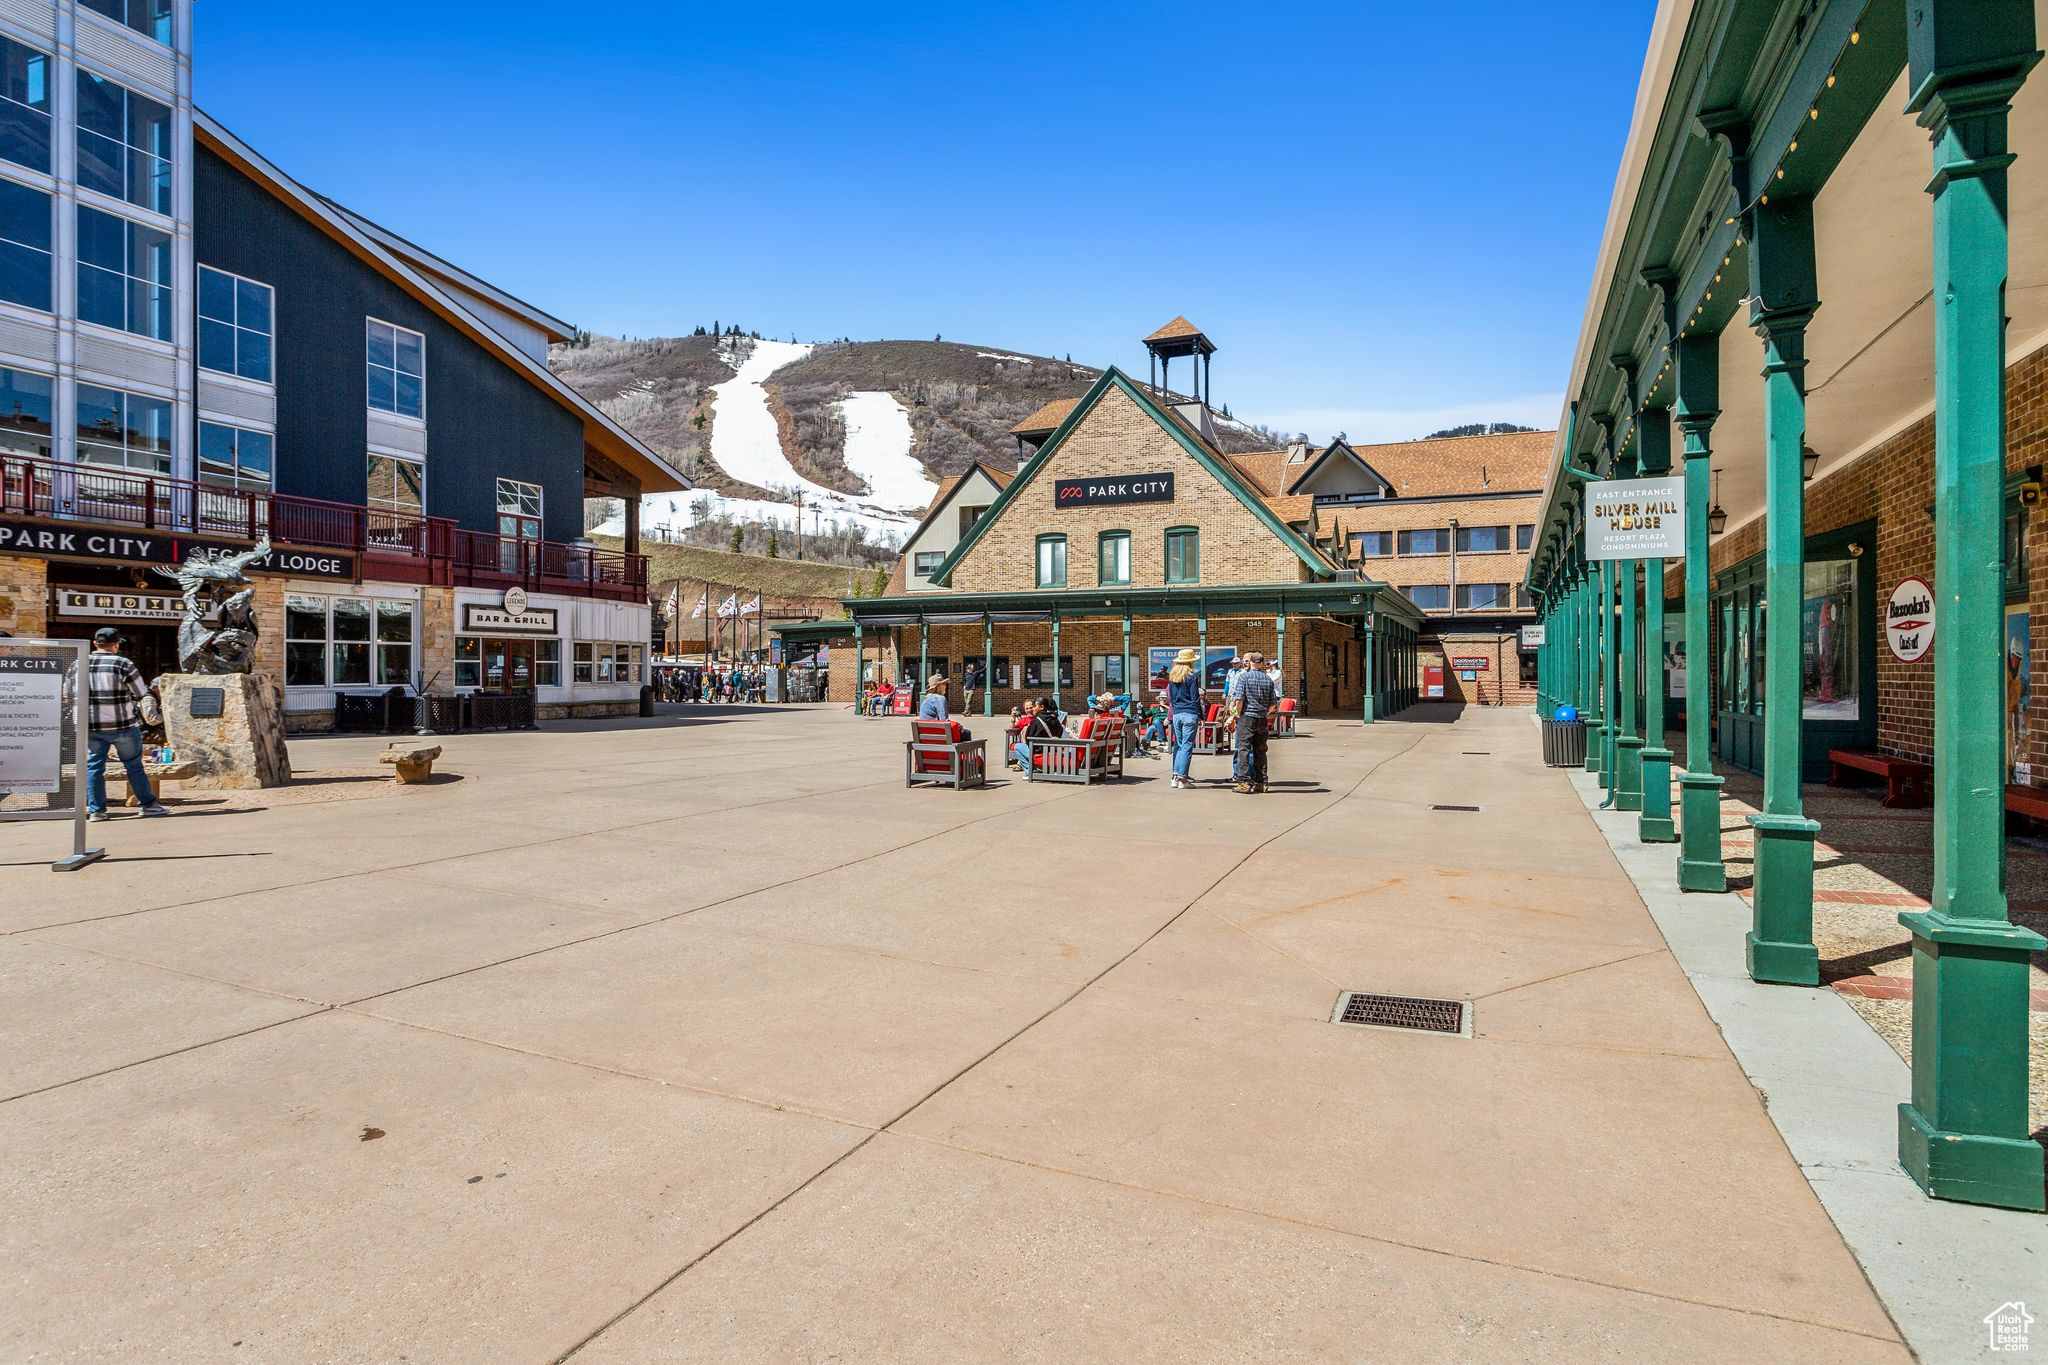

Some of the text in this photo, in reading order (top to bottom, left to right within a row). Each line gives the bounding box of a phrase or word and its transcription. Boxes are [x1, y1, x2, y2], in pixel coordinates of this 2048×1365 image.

[1089, 481, 1168, 497] PARK CITY
[1597, 487, 1673, 499] EAST ENTRANCE
[1594, 500, 1677, 518] SILVER MILL
[1610, 515, 1661, 531] HOUSE
[0, 527, 152, 557] PARK CITY
[1639, 533, 1666, 541] PLAZA
[1601, 542, 1669, 551] CONDOMINIUMS
[280, 554, 341, 574] LODGE
[104, 609, 180, 618] INFORMATION
[1889, 595, 1930, 618] Bazooka's
[514, 617, 547, 625] GRILL
[24, 660, 57, 669] CITY
